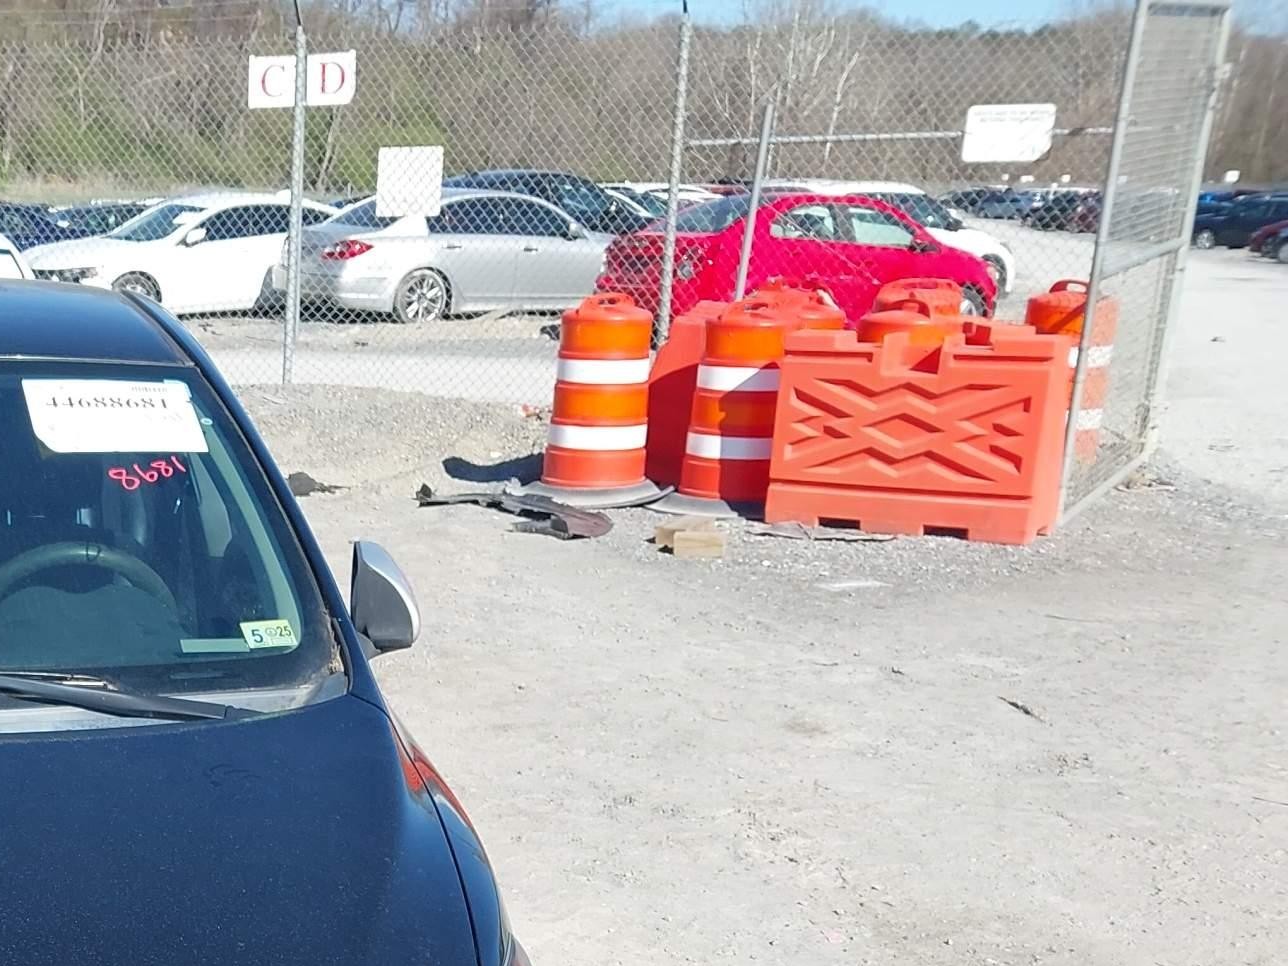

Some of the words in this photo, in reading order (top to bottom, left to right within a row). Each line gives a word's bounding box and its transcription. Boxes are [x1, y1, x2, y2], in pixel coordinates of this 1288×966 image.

[261, 64, 285, 98] C
[319, 61, 345, 95] D
[108, 456, 186, 490] 8681
[251, 628, 264, 644] 5
[276, 625, 292, 638] 25
